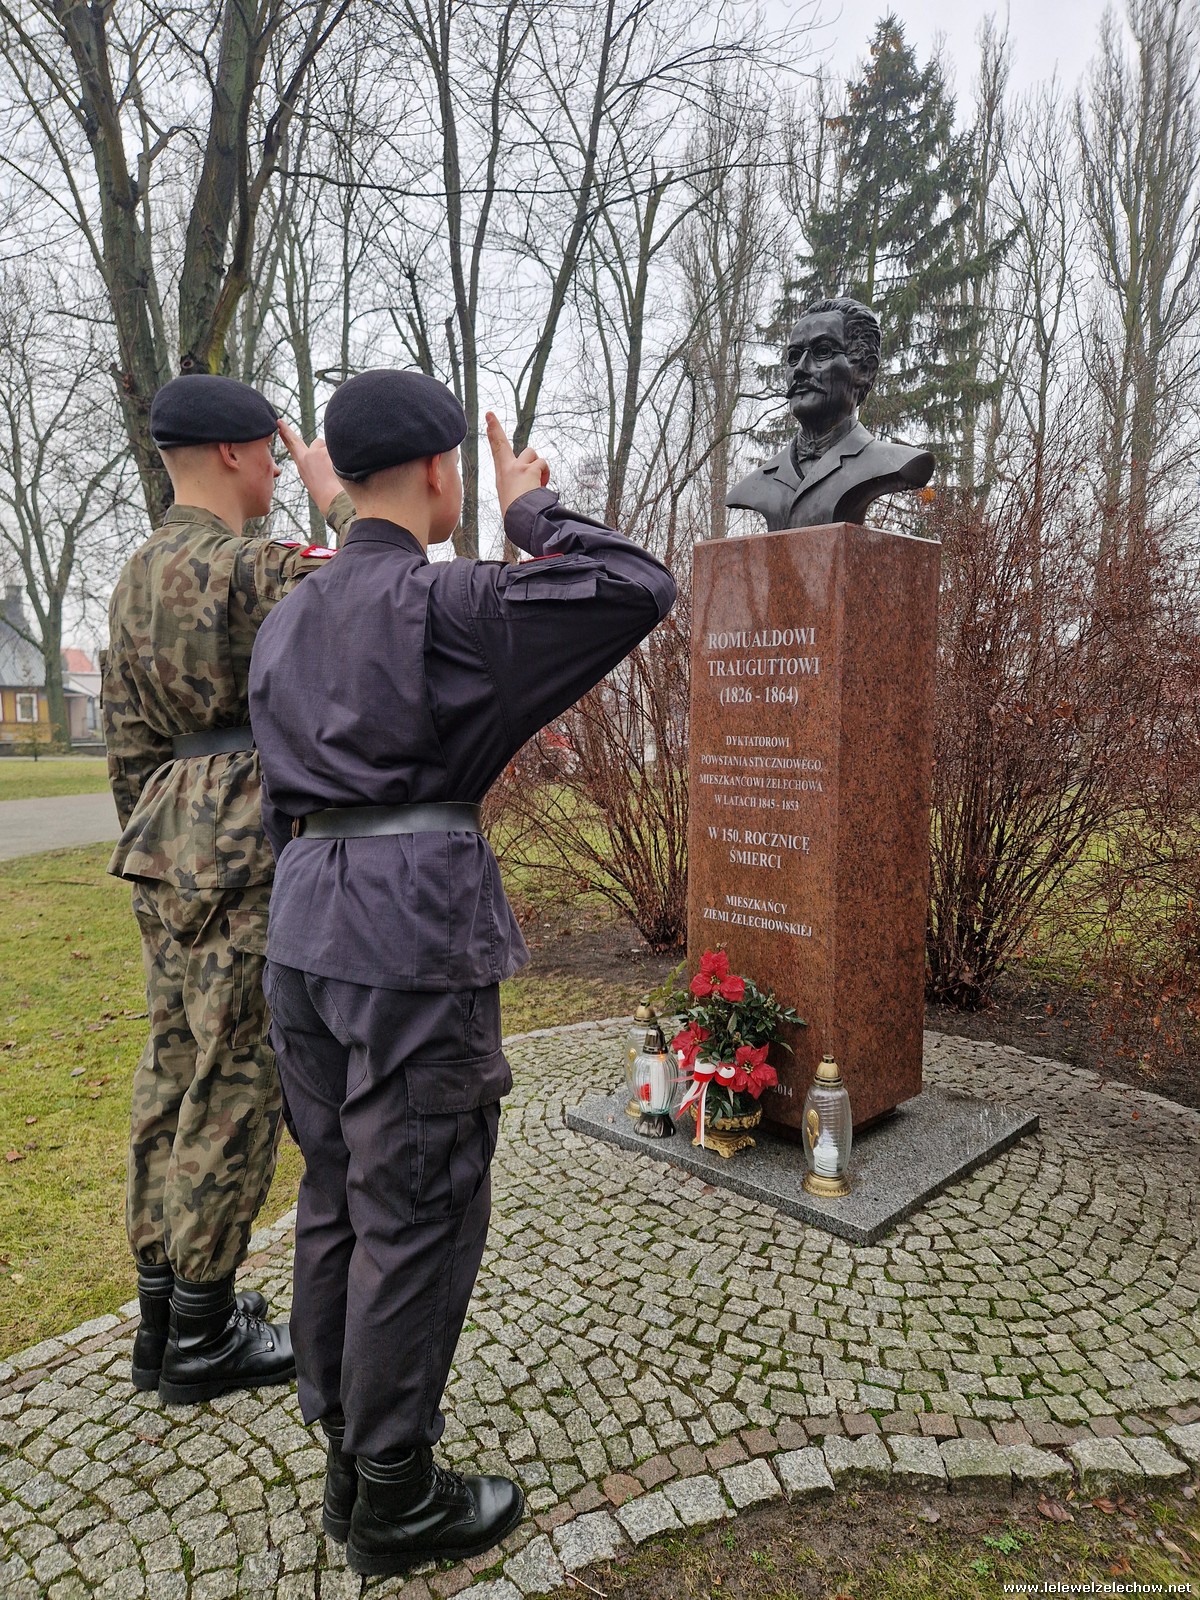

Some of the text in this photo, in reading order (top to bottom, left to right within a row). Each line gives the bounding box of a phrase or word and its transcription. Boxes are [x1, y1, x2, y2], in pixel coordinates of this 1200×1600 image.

[708, 627, 816, 650] ROMUALDOWI
[707, 657, 820, 677] TRAUGUTTOWI
[720, 687, 752, 706] (1826
[765, 686, 799, 706] 1864)
[726, 735, 790, 748] DYKTATOROWI
[701, 754, 748, 767] POWSTANIA
[766, 776, 823, 792] ŻELECHOWA
[714, 794, 722, 804] W
[723, 795, 757, 808] LATACH
[758, 799, 775, 809] 1845
[782, 799, 799, 811] 1853
[708, 826, 810, 855] W 150. ROCZNICĘ
[729, 845, 782, 869] ŚMIERCI
[725, 894, 788, 915] MIESZKAŃCY
[703, 908, 813, 937] ZIEMI ŻELECHOWSKIEJ
